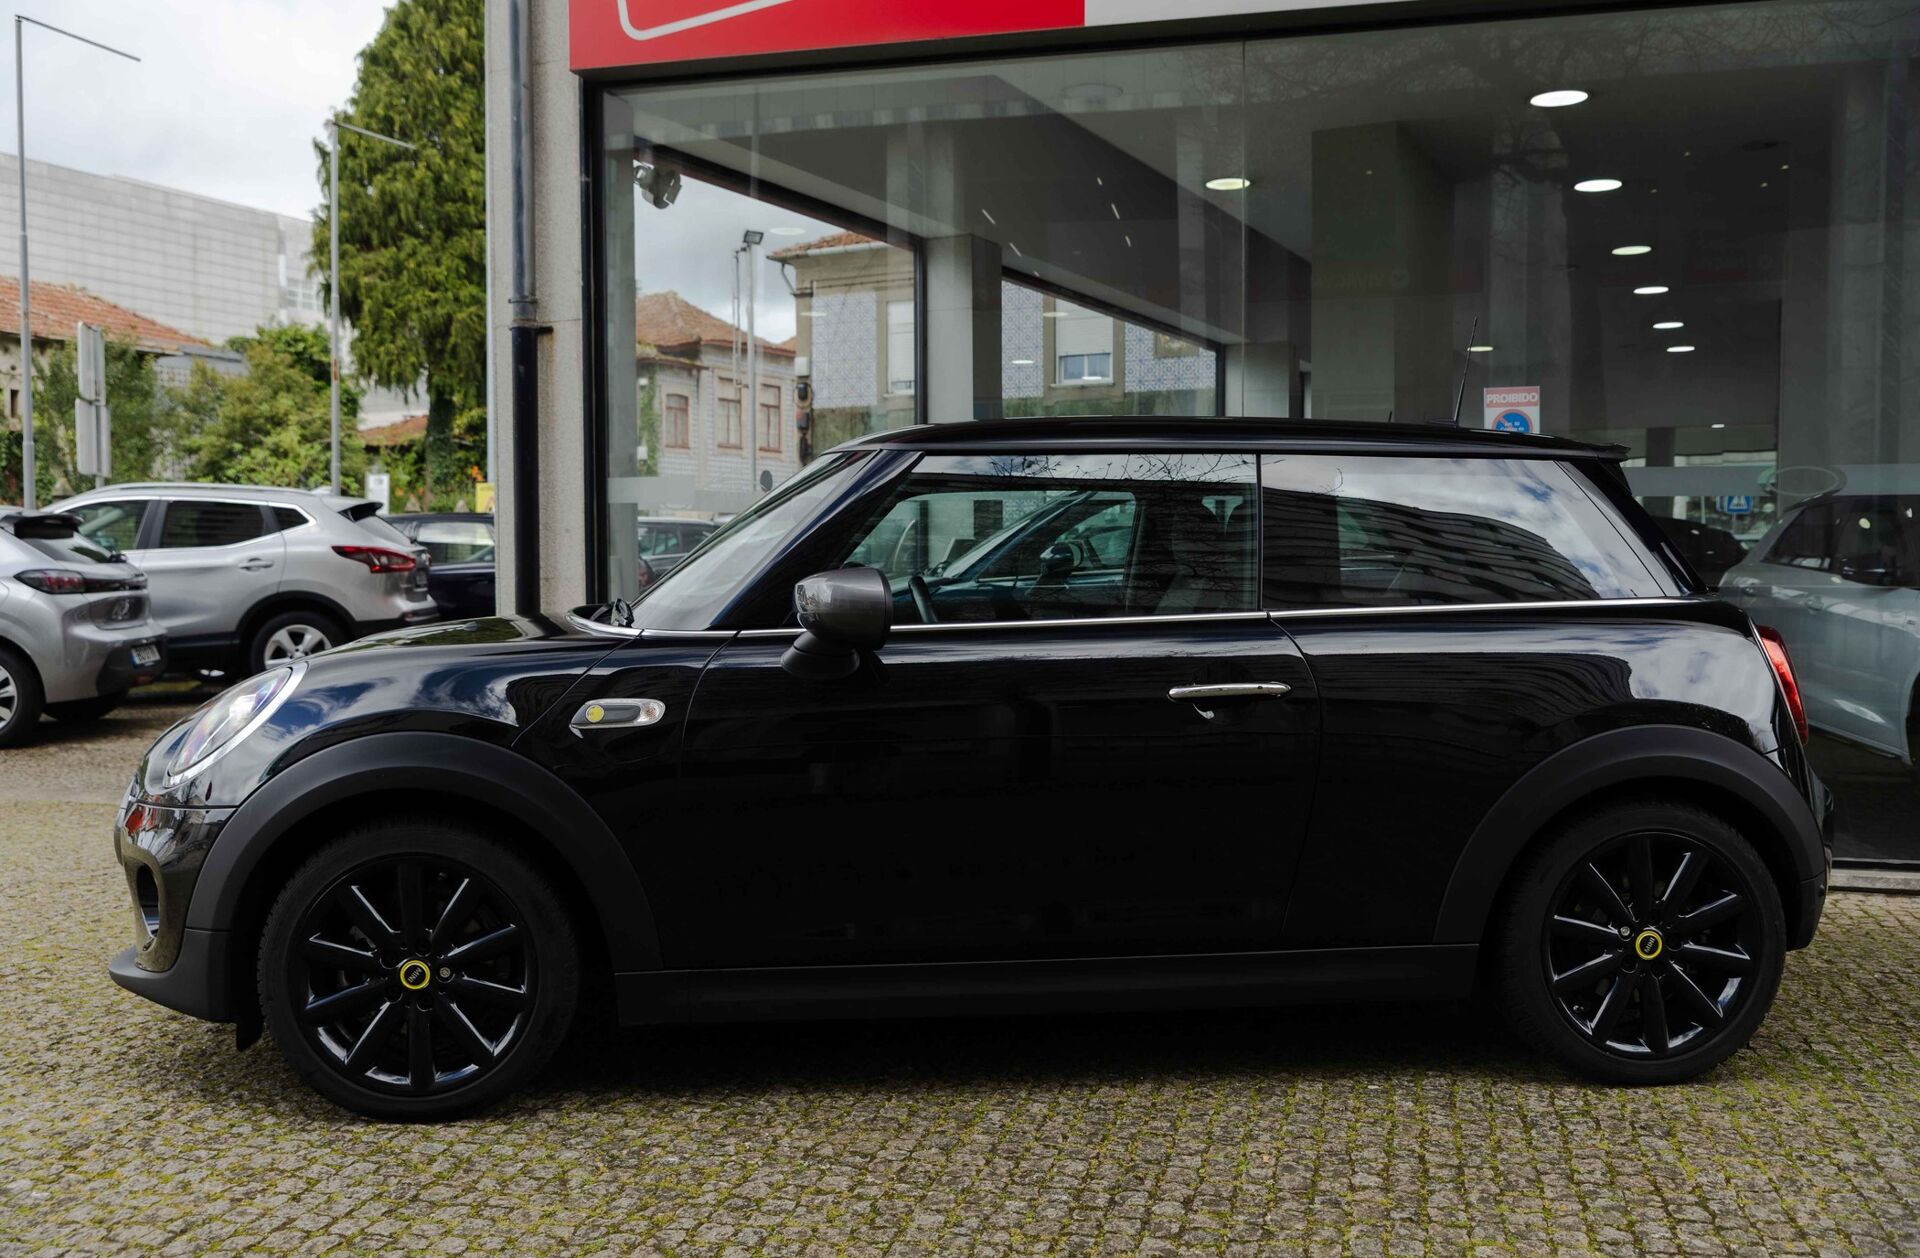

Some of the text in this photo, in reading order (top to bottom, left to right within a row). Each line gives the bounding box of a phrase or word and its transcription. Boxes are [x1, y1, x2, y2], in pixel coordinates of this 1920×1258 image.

[1486, 392, 1538, 404] PROIBIDO
[1643, 937, 1656, 953] MINI
[407, 967, 423, 983] MINI
